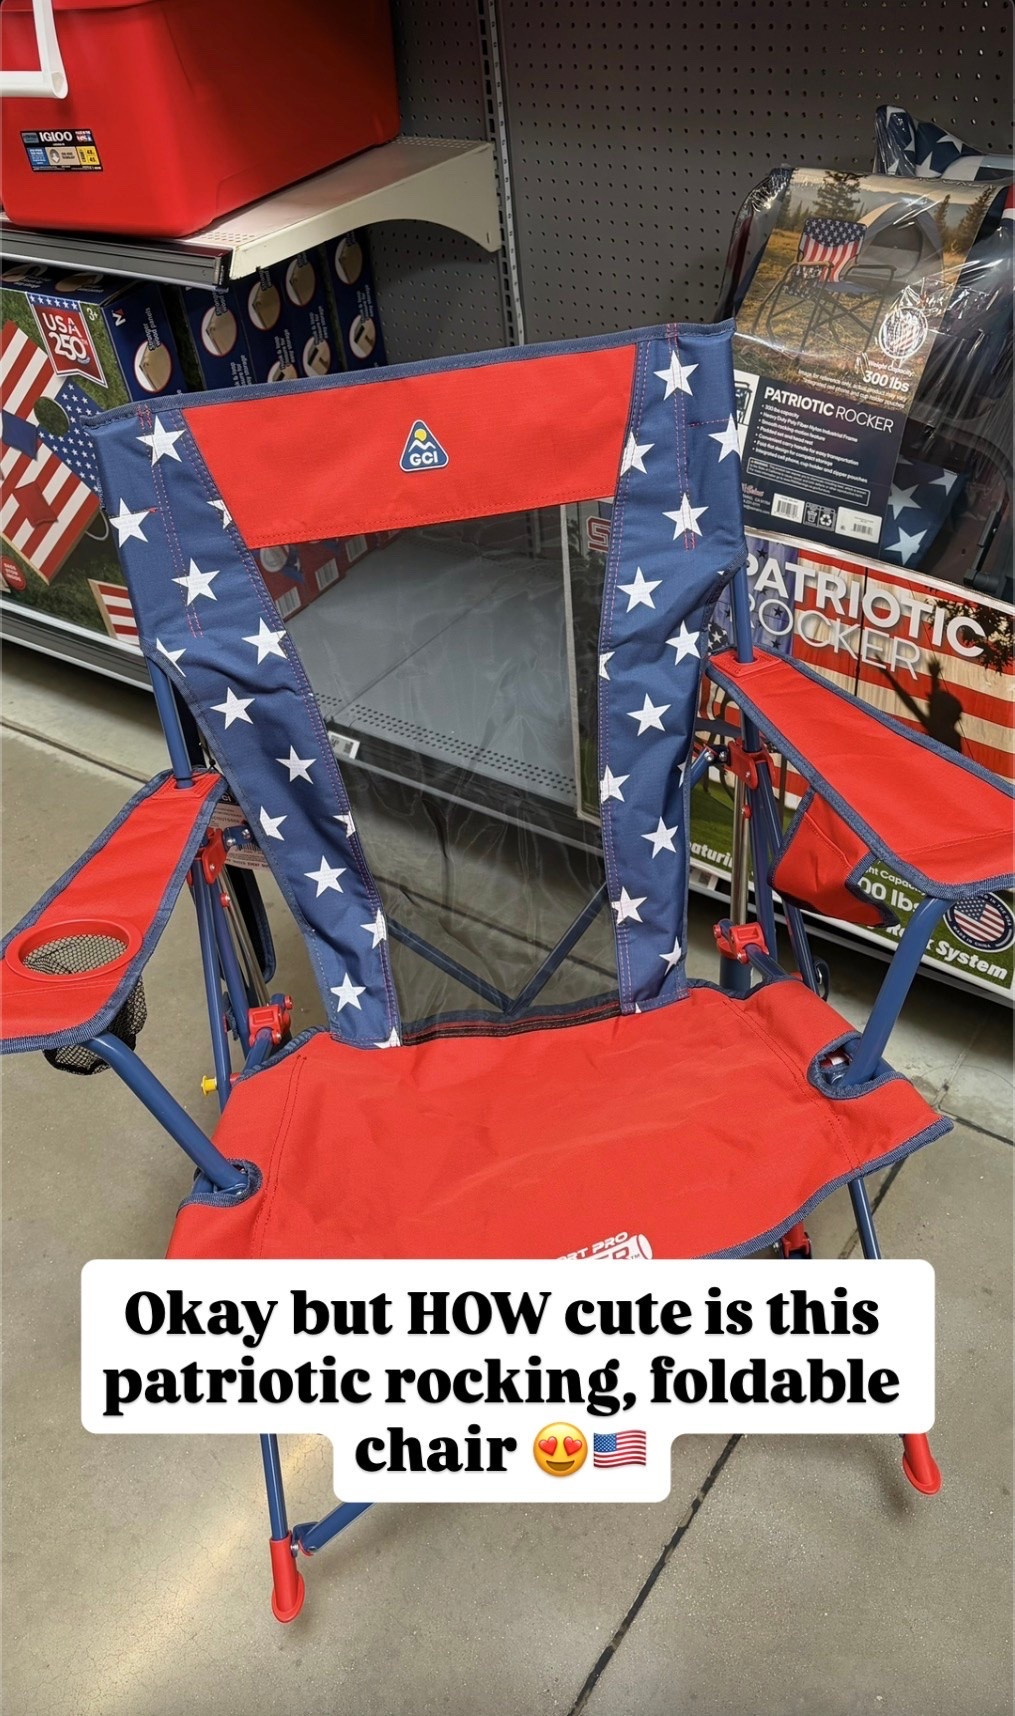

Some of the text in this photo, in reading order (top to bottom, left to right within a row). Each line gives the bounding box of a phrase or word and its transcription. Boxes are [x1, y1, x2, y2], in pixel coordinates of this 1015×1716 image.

[39, 131, 73, 142] IGLOO
[42, 312, 82, 338] USA
[86, 307, 98, 321] 3+
[48, 331, 87, 361] 250
[863, 370, 889, 387] 300
[764, 387, 894, 433] PATRIOTIC ROCKER
[409, 450, 438, 466] GCI
[746, 552, 987, 658] PATRIOTIC
[935, 939, 1008, 980] System
[592, 1231, 628, 1254] PRO
